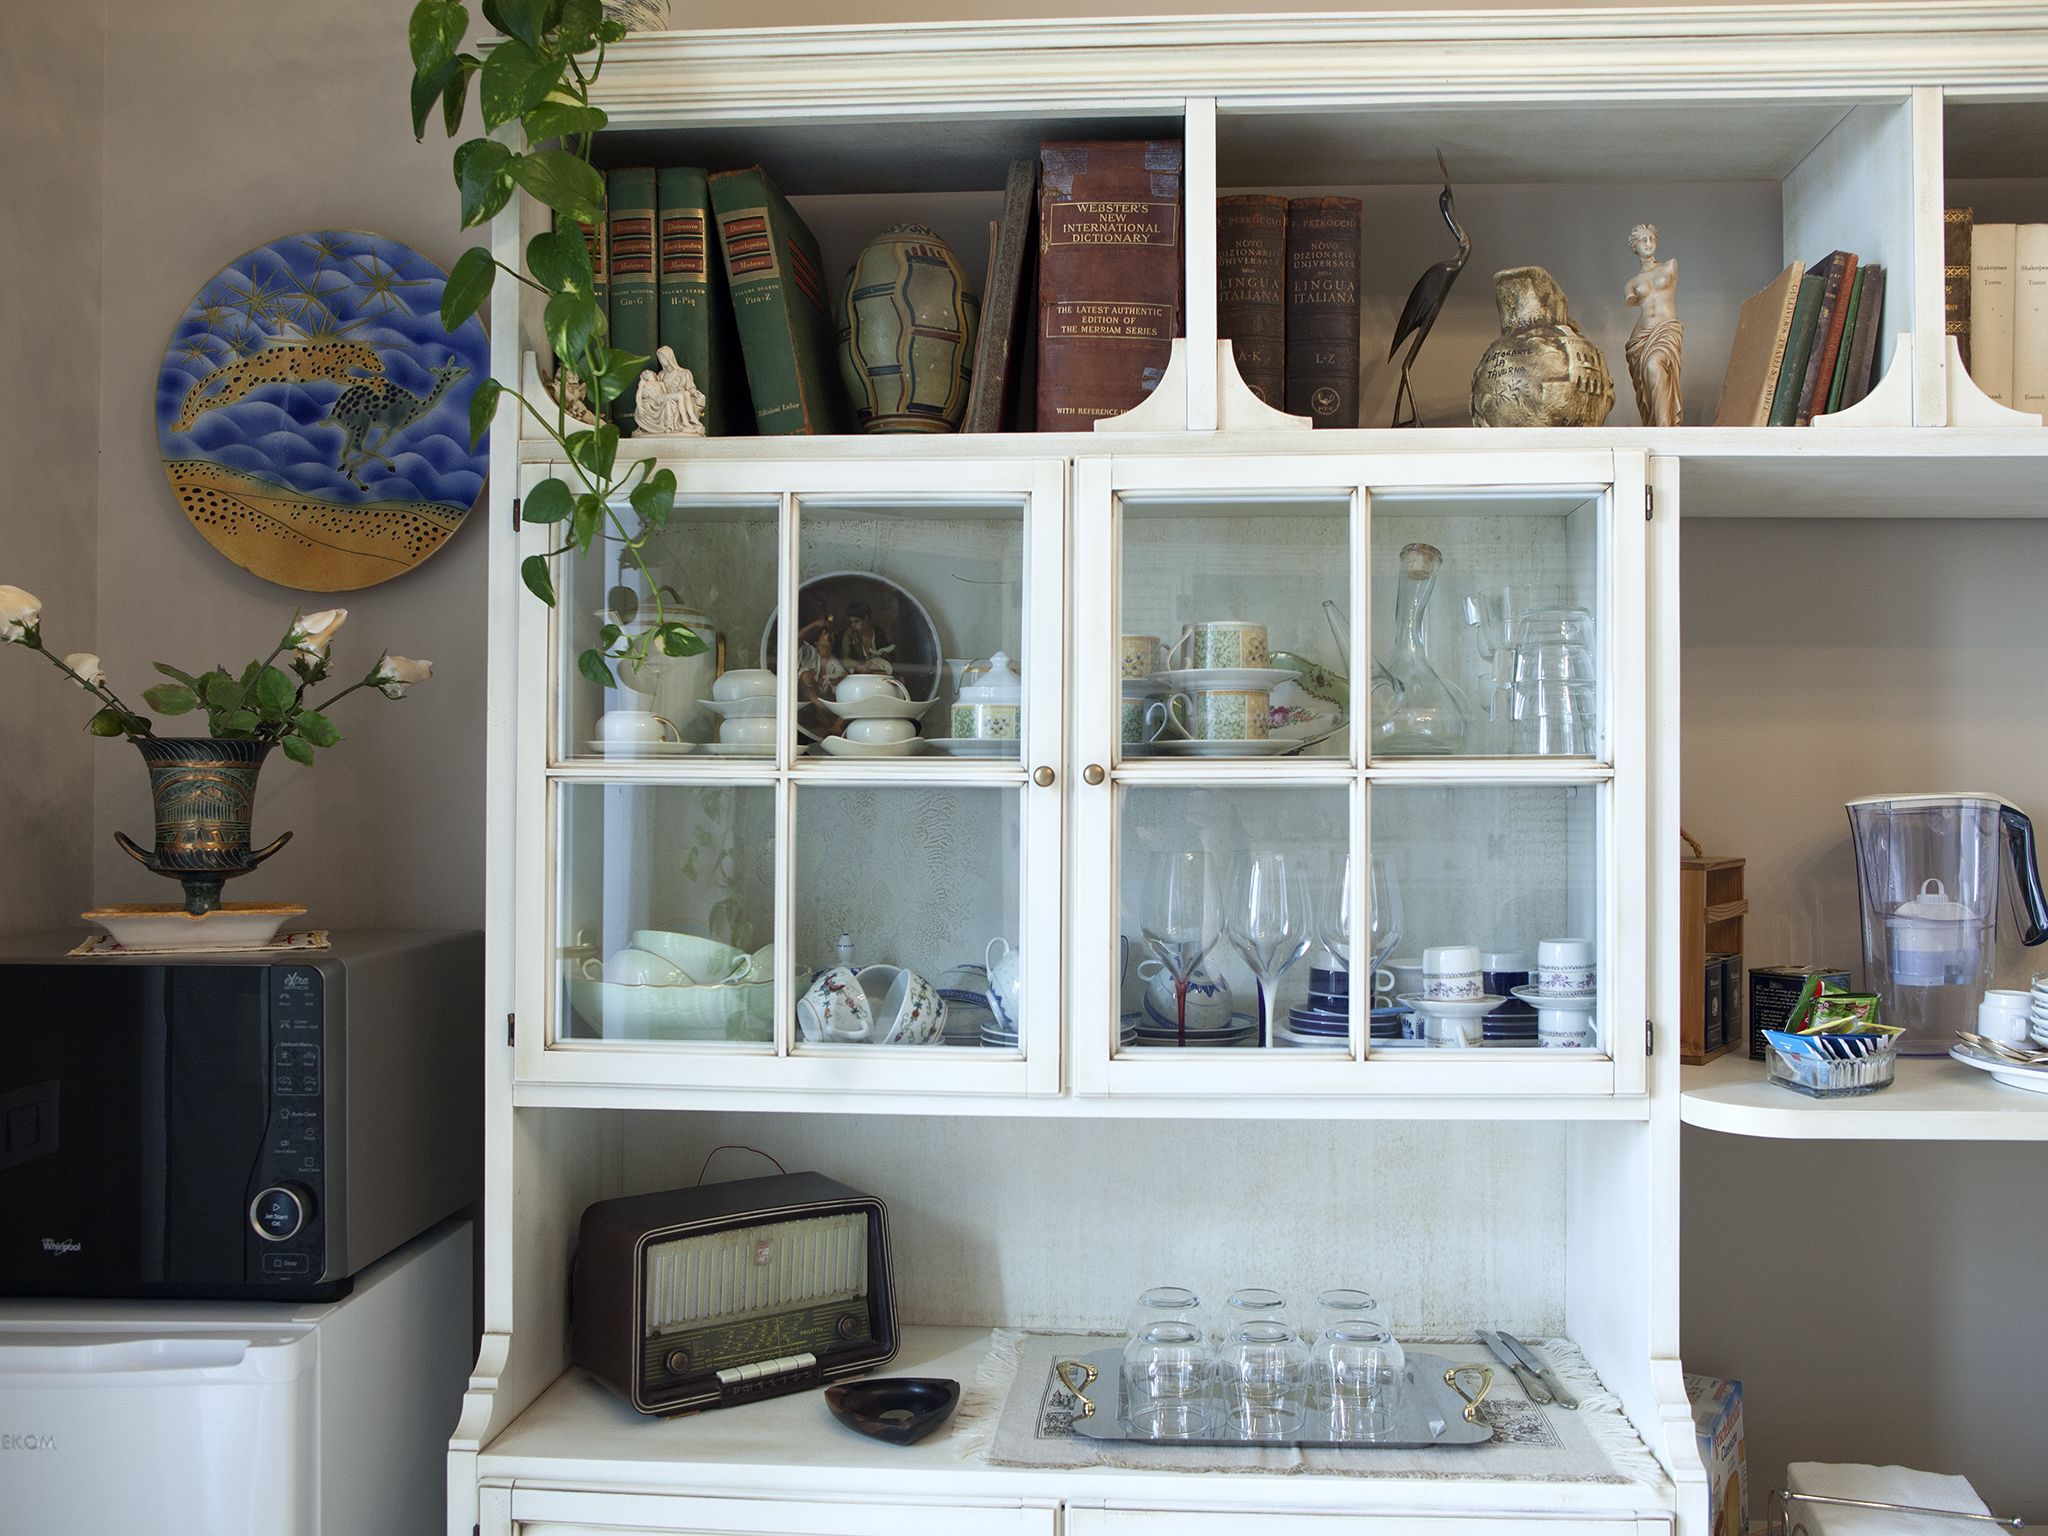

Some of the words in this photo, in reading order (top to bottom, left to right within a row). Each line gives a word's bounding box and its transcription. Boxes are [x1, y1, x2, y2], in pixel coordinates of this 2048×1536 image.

[1076, 203, 1149, 214] WEBSTER'S
[1099, 213, 1127, 223] NEW
[1063, 223, 1161, 233] INTERNATIONAL
[1072, 233, 1151, 243] DICTIONARY
[1219, 278, 1280, 290] LINGUA
[1294, 280, 1356, 291] LINGUA
[1219, 290, 1280, 302] ITALIANA
[1294, 292, 1356, 304] ITALIANA
[1056, 306, 1073, 314] THE
[1076, 306, 1110, 314] LATEST
[1111, 307, 1163, 317] AUTHENTIC
[1082, 316, 1119, 325] EDITION
[1123, 317, 1137, 325] OF
[1061, 325, 1078, 334] THE
[1080, 326, 1122, 334] MERRIAM
[1125, 327, 1158, 336] SERIES
[1493, 360, 1506, 369] LA
[1487, 366, 1526, 380] TAVERNA
[1056, 407, 1076, 415] WITH
[1078, 408, 1119, 416] REFERENCE
[42, 1238, 81, 1256] Whirlpool
[0, 1434, 58, 1450] EKOM
